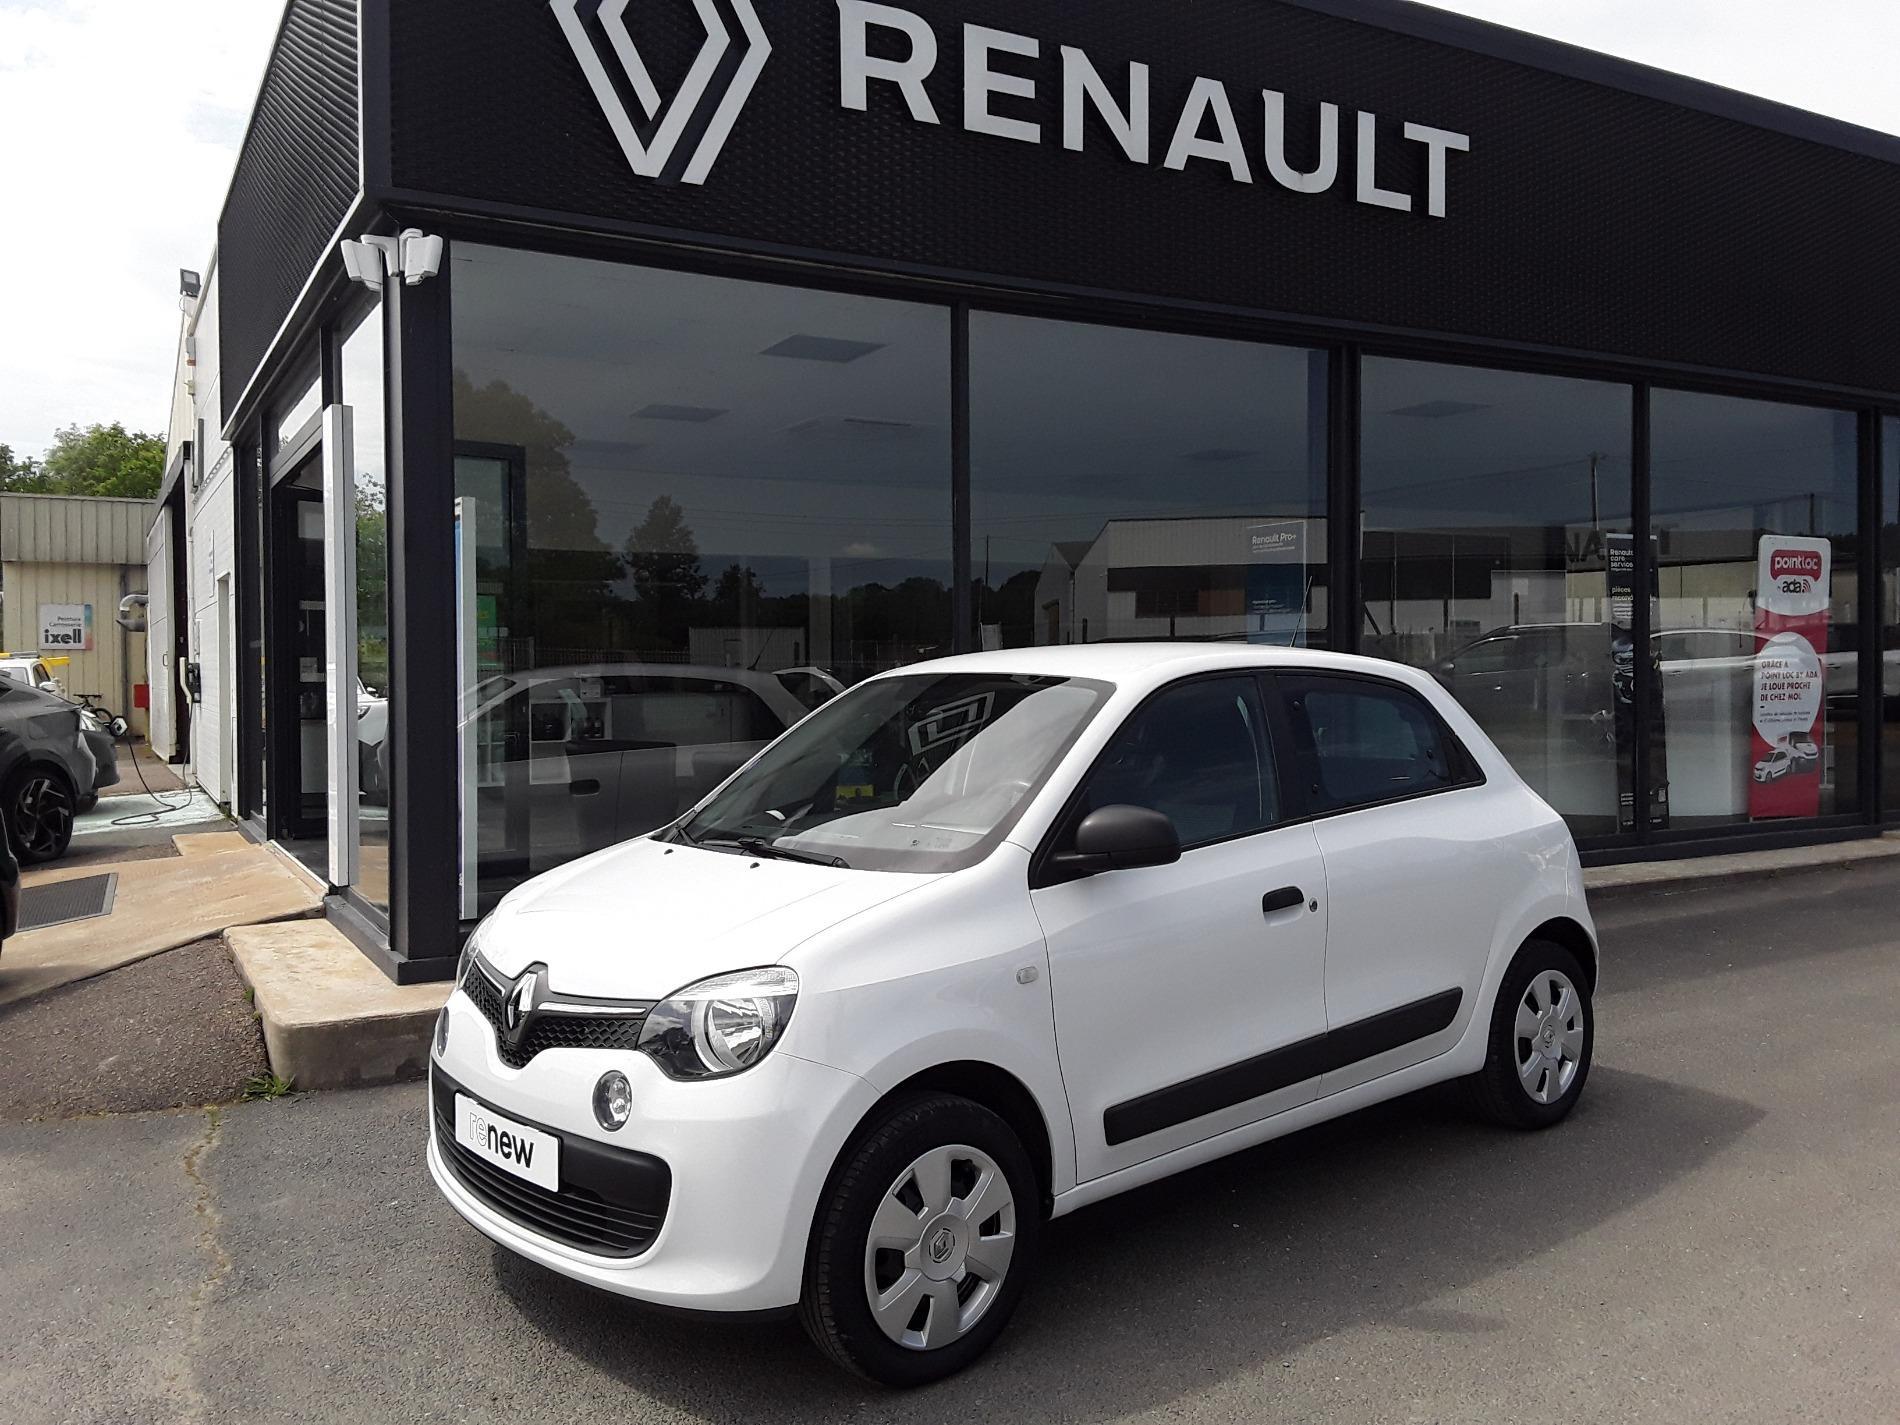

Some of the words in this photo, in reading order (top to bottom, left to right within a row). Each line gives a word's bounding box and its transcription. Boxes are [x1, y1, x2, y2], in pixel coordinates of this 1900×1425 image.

[835, 0, 1470, 218] RENAULT
[1252, 534, 1279, 544] Renault
[1782, 579, 1801, 593] ada
[44, 628, 82, 644] ixell
[1761, 671, 1780, 679] POINT
[1782, 671, 1794, 679] LOC
[1796, 671, 1803, 679] BY
[1761, 682, 1767, 690] JE
[1769, 682, 1785, 690] LOUE
[1786, 681, 1811, 690] PROCHE
[1770, 693, 1786, 701] CHEZ
[470, 1112, 534, 1168] renew
